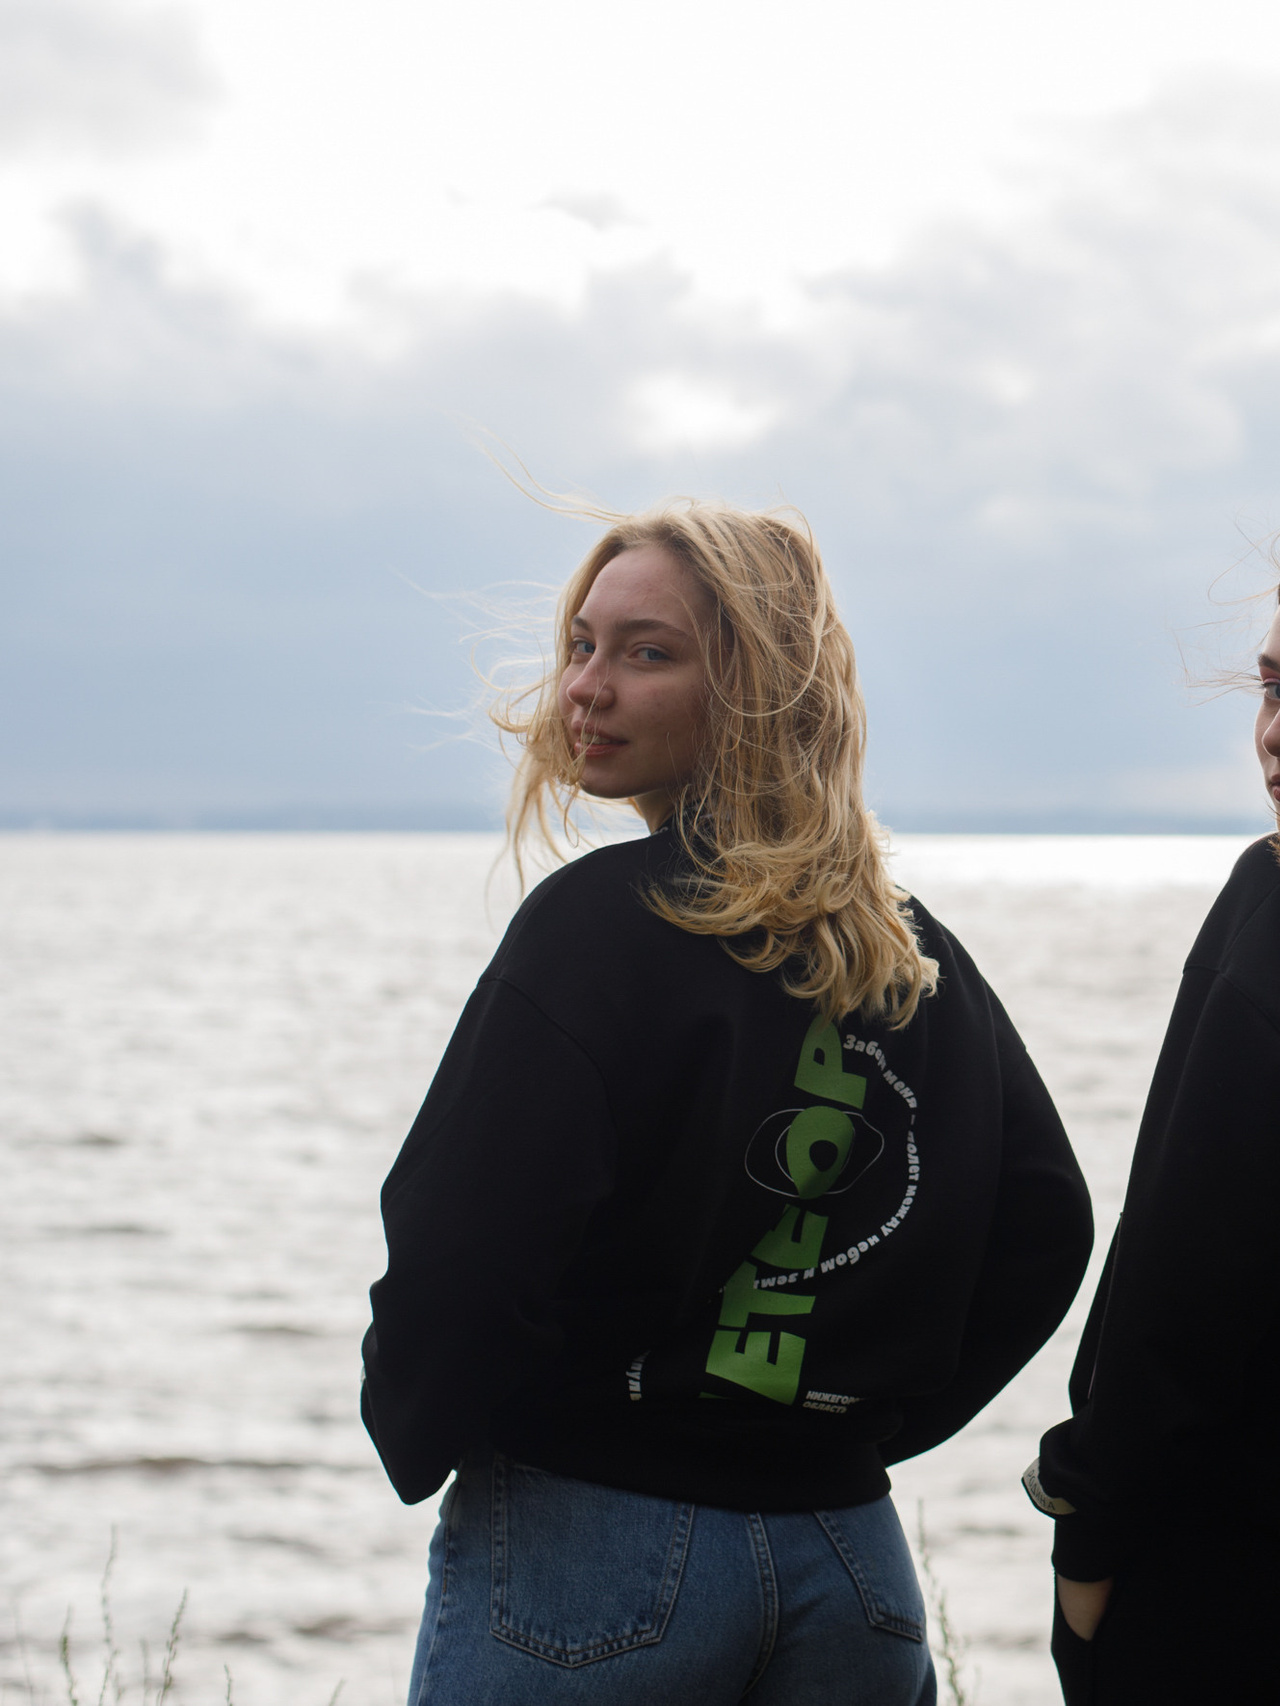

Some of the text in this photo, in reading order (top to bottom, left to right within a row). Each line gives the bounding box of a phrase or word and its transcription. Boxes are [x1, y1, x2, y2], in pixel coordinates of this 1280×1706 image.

[883, 1069, 918, 1109] меня
[906, 1130, 920, 1181] полет
[700, 1013, 868, 1406] ЕТЕОР
[880, 1184, 917, 1237] между
[803, 1267, 815, 1280] и
[820, 1234, 881, 1274] небом
